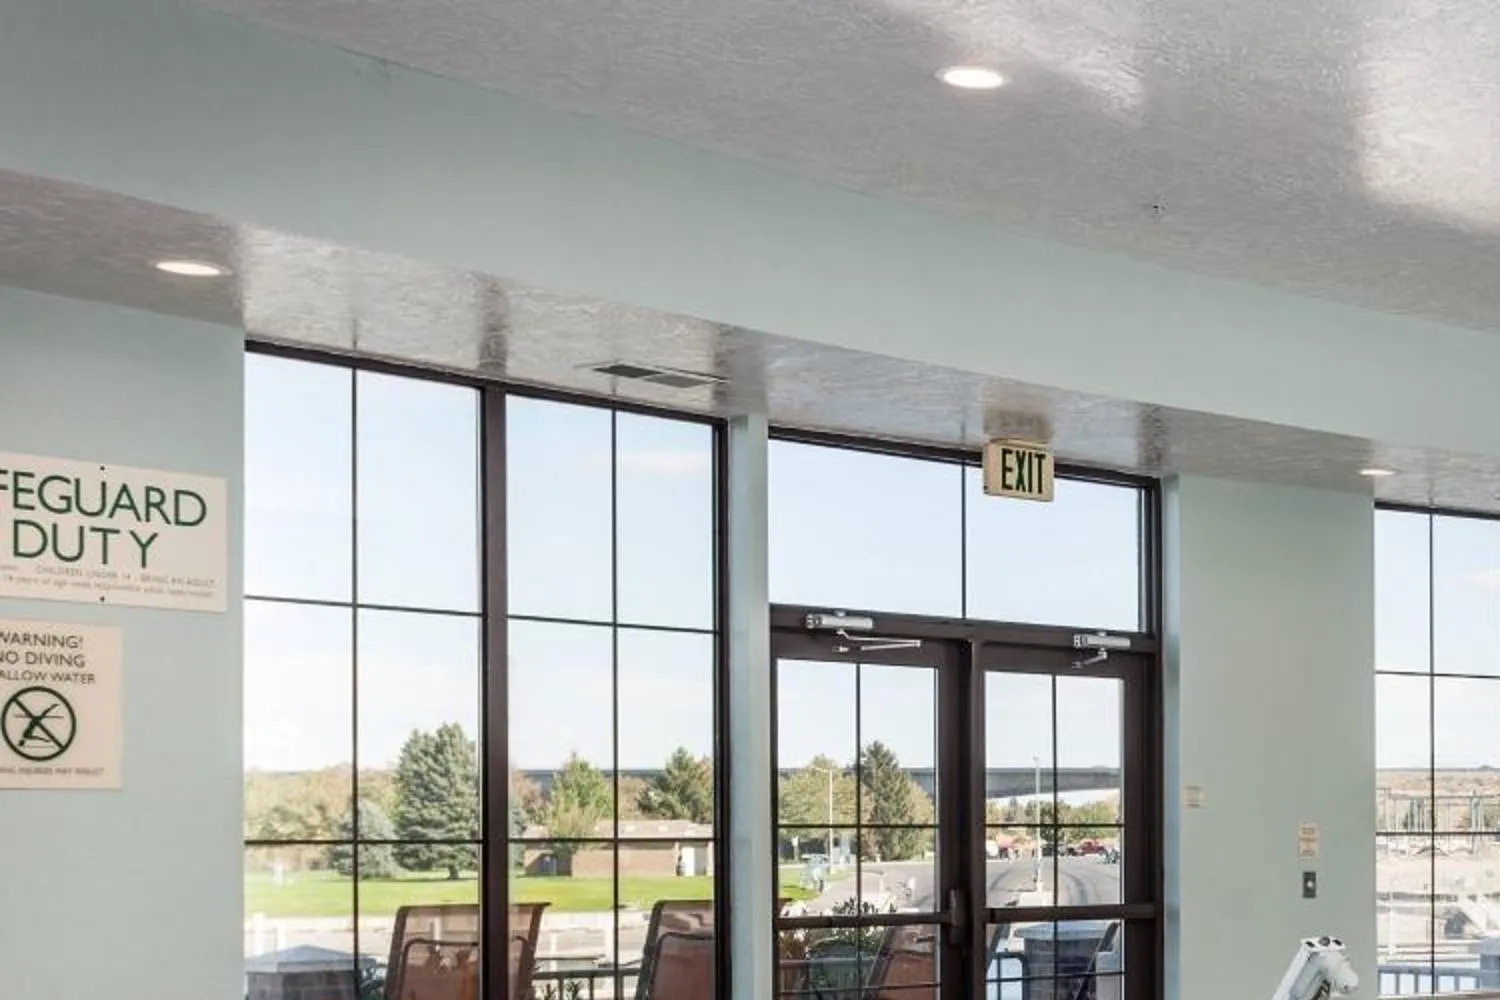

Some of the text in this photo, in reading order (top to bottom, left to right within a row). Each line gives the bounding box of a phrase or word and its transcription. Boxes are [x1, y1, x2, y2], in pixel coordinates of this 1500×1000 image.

[1001, 447, 1046, 494] EXIT
[12, 518, 159, 569] DUTY
[25, 651, 86, 669] DIVING
[50, 672, 96, 685] WATER
